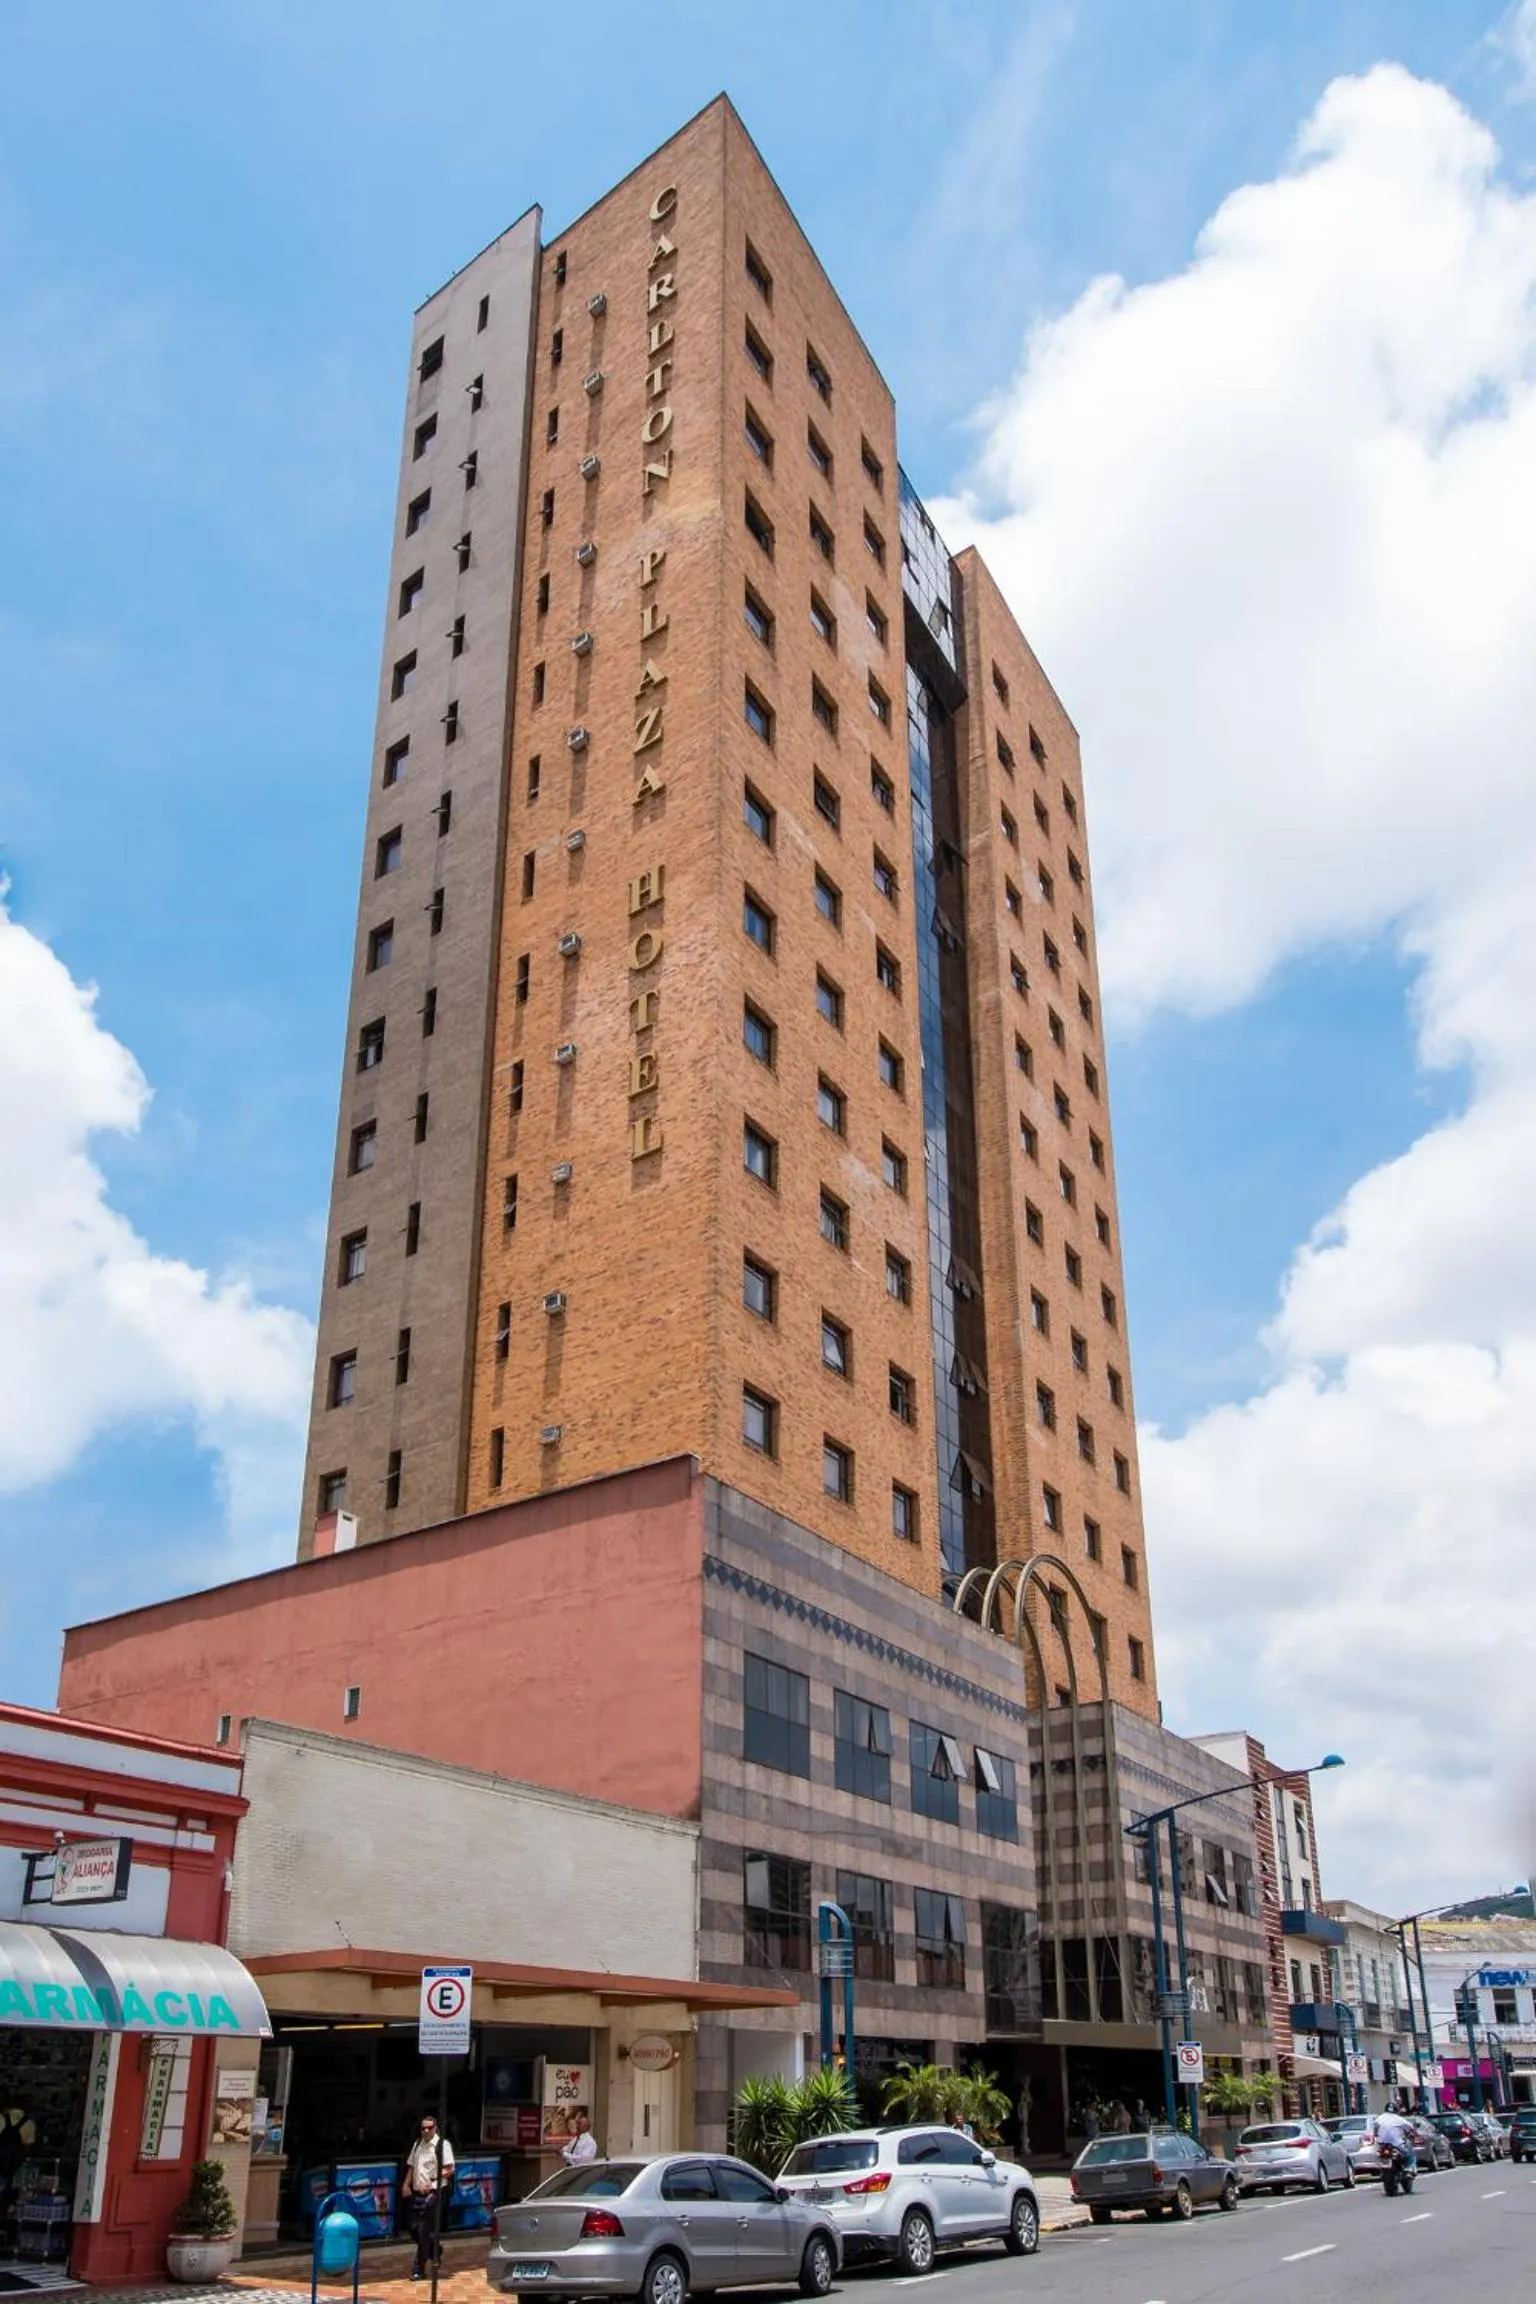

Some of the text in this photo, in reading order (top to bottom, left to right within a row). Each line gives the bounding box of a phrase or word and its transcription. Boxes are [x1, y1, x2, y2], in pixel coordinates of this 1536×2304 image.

[642, 184, 678, 497] CARLTON
[632, 551, 669, 806] PLAZA
[627, 864, 665, 1162] HOTEL
[72, 1861, 115, 1878] ALIANÇA
[0, 1980, 241, 2029] ARMÁCIA
[439, 1986, 454, 2010] E
[555, 2081, 579, 2103] pão
